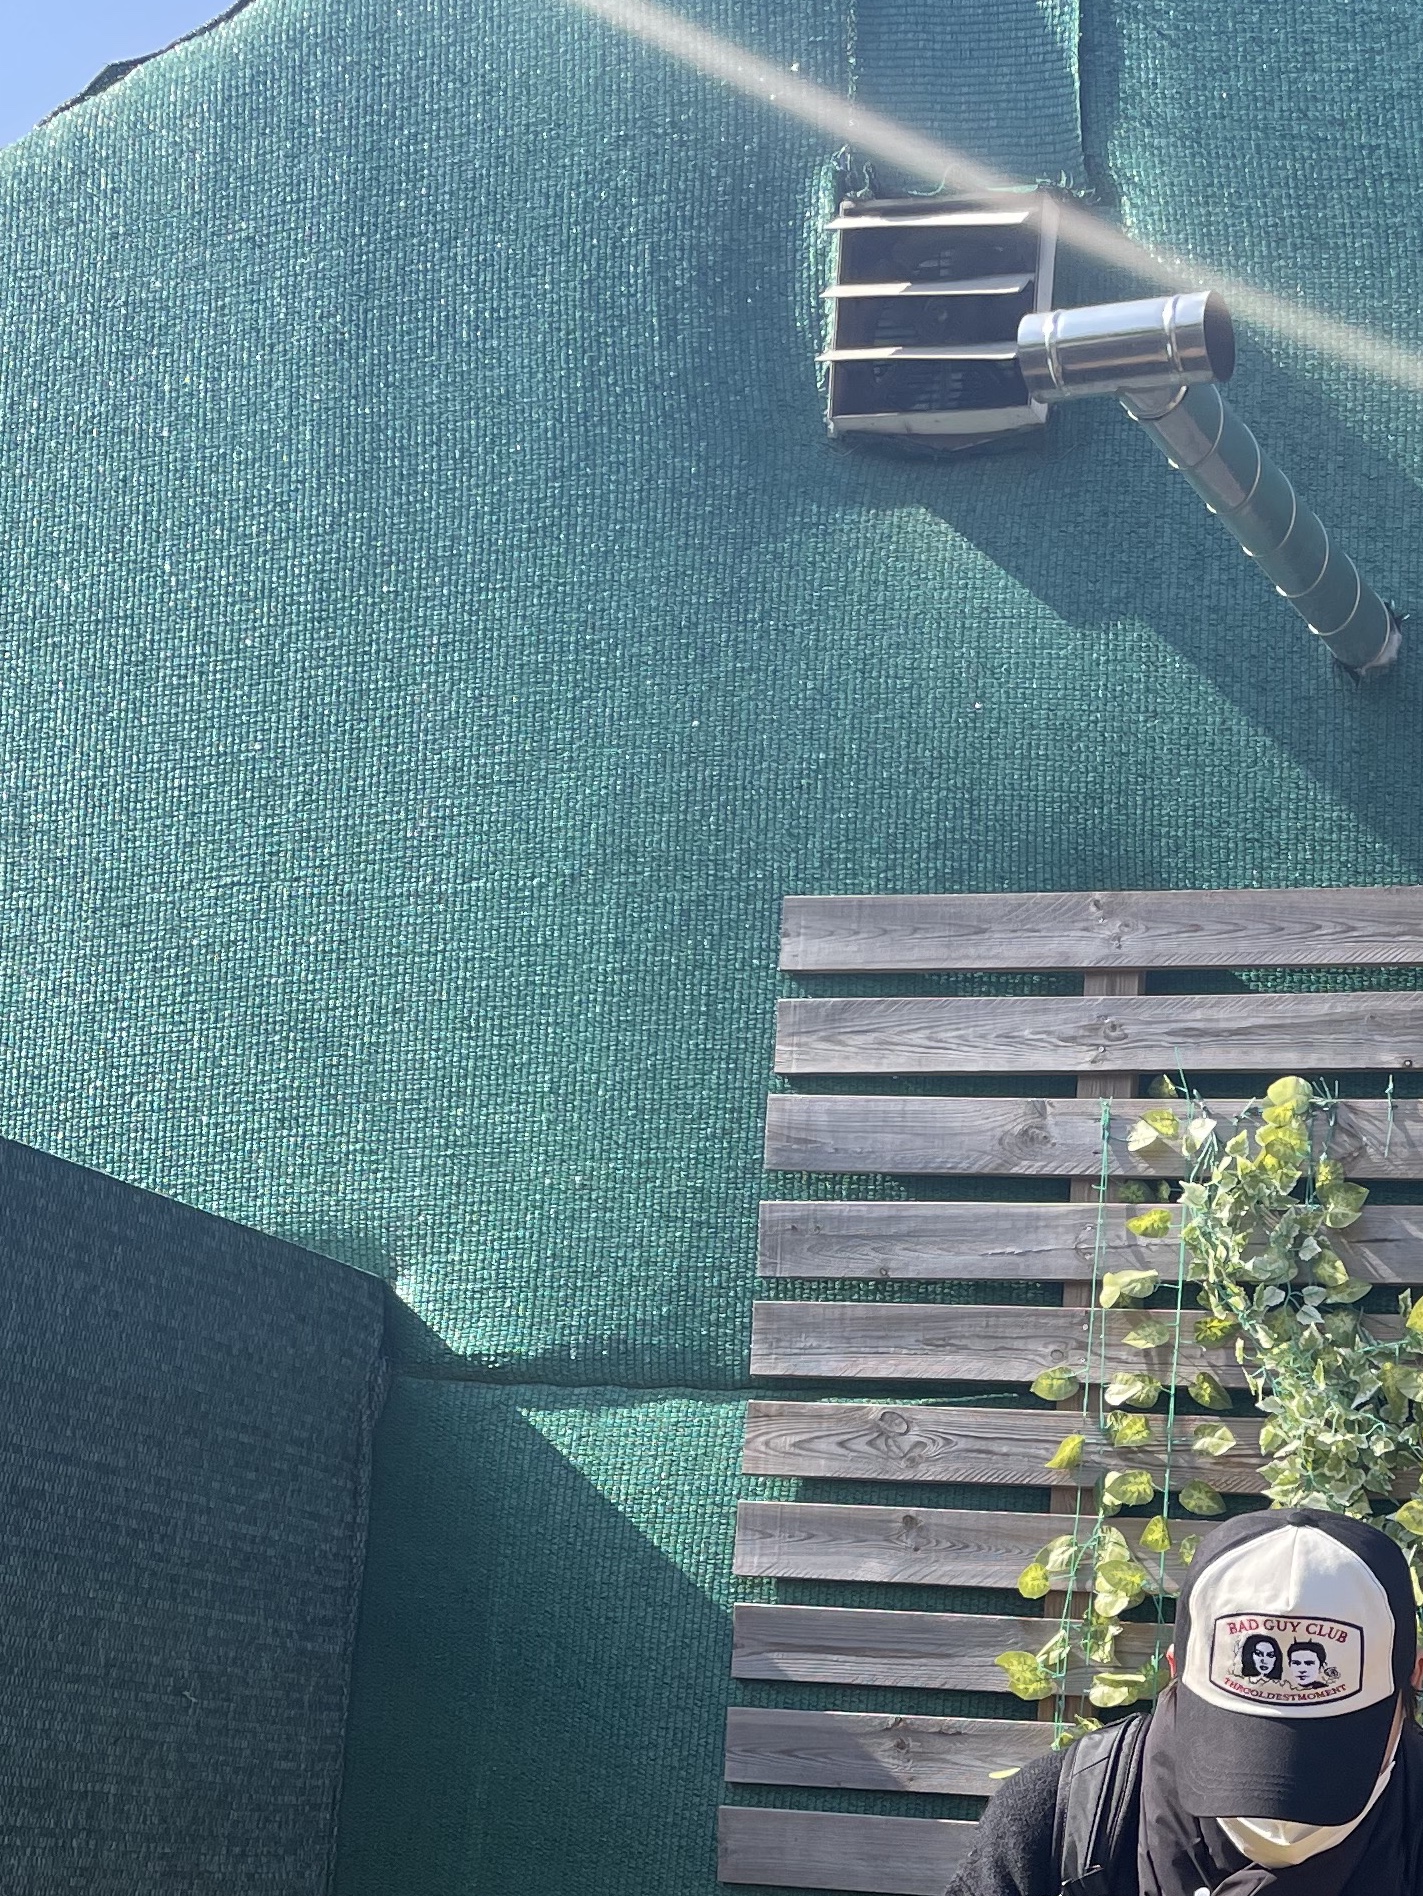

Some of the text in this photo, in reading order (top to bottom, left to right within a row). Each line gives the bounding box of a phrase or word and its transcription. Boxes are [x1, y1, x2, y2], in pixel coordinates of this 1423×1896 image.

[1227, 1619, 1348, 1643] BAD GUY CLUB
